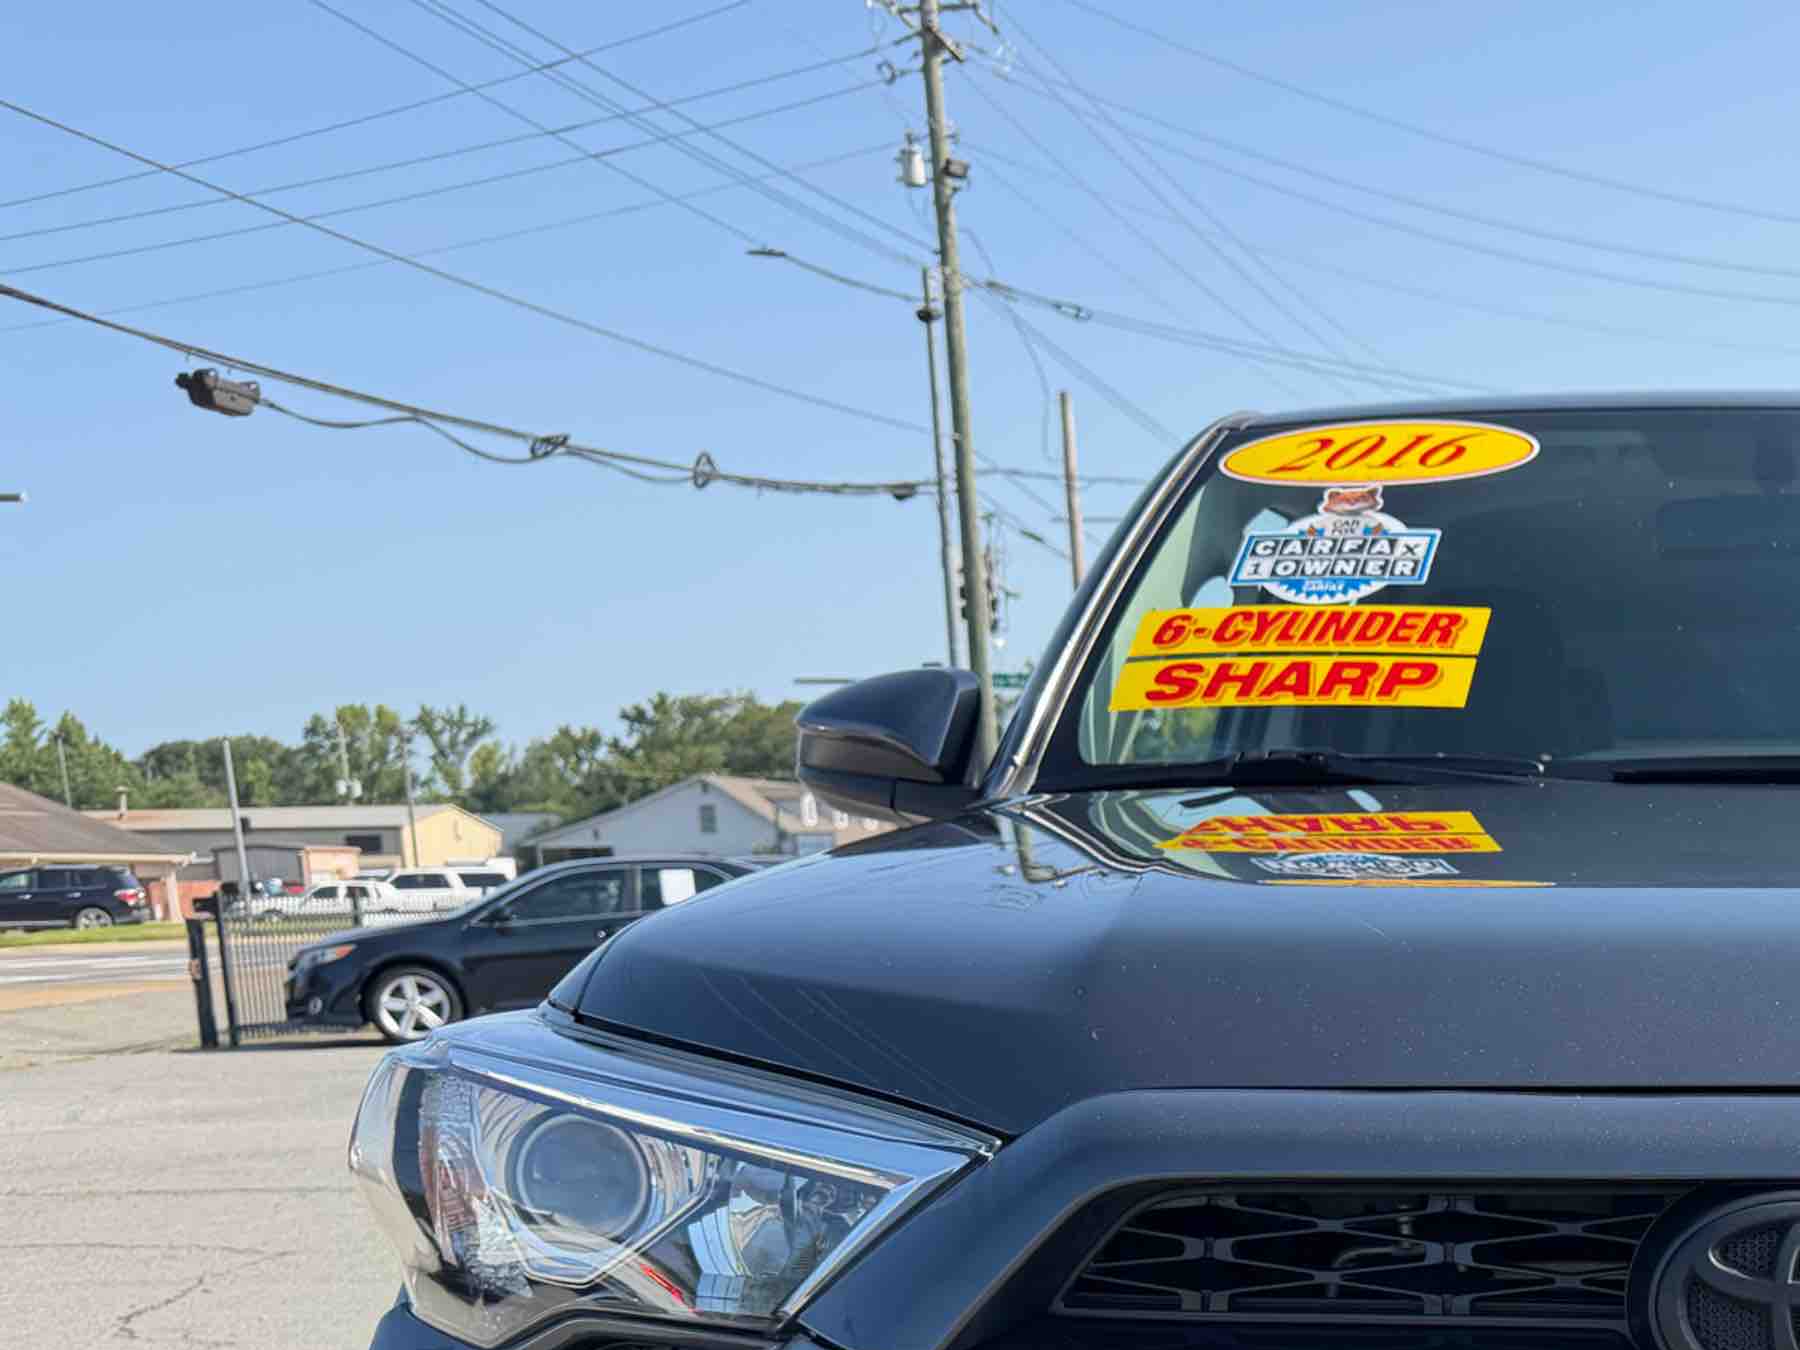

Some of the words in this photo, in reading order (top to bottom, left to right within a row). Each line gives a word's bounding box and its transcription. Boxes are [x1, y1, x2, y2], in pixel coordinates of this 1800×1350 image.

[1267, 432, 1484, 474] 2016
[1254, 539, 1424, 556] CARFAX
[1274, 558, 1417, 577] OWNER
[1151, 610, 1468, 648] 6-CYLINDER
[1145, 660, 1443, 702] SHARP
